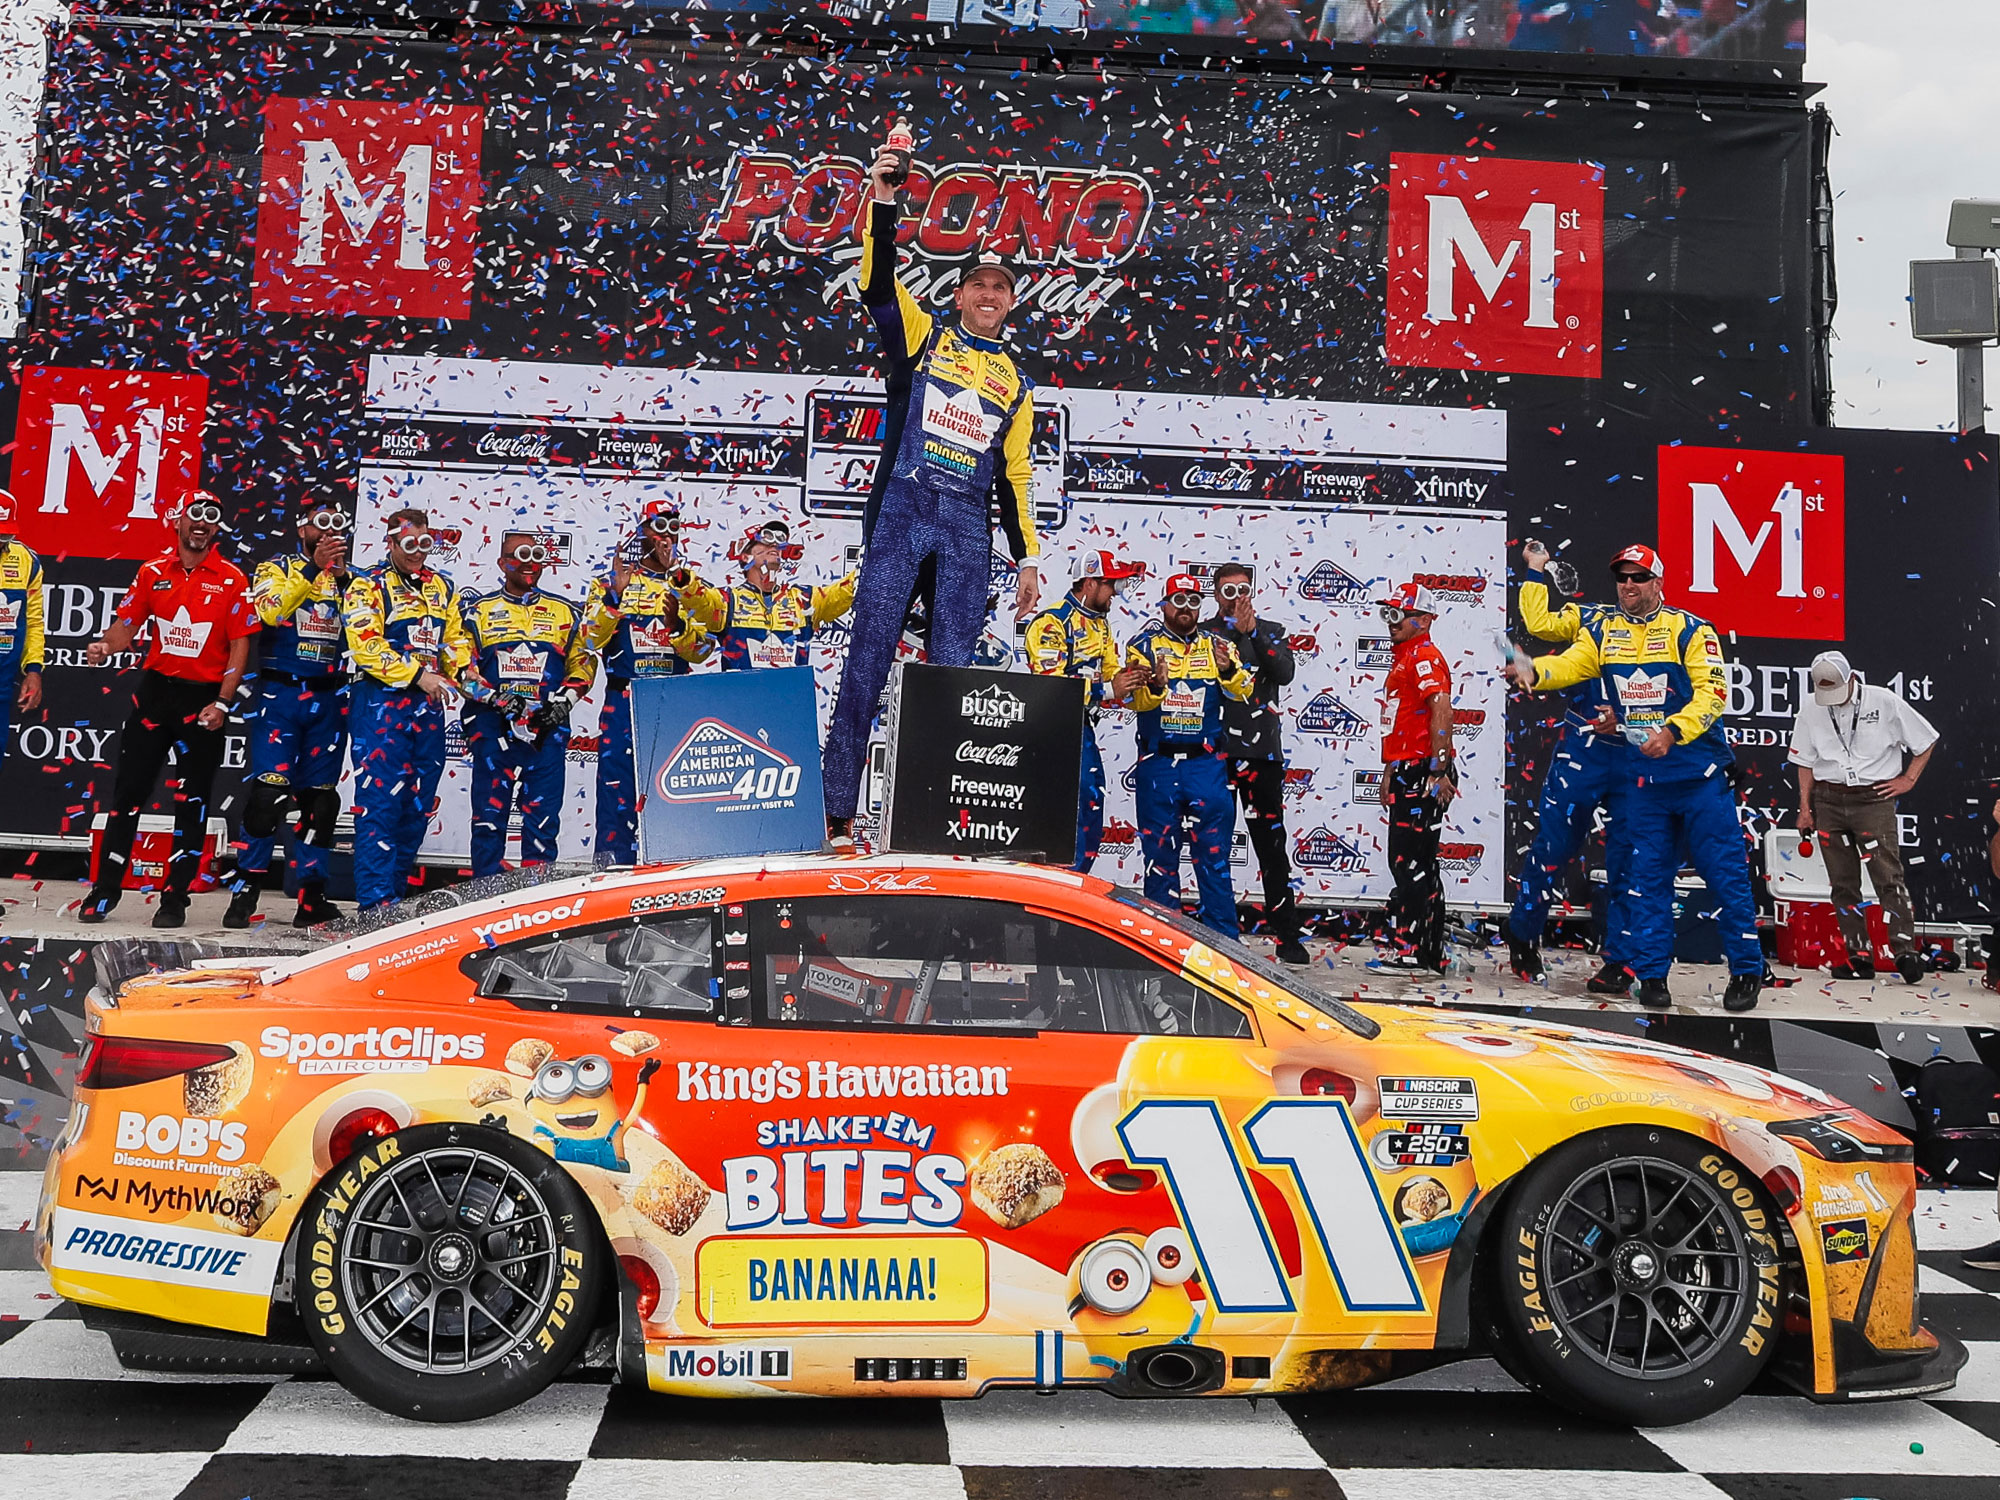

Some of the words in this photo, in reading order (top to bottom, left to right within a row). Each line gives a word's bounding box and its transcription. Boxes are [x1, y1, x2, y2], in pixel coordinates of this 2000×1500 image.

[827, 0, 861, 17] LIGH
[926, 409, 988, 444] Hawaiian
[944, 402, 984, 428] King's
[598, 437, 662, 463] Freeway
[925, 440, 977, 467] minions
[1303, 469, 1366, 490] Freeway
[1414, 475, 1488, 503] xfinity
[201, 583, 224, 593] TOYOTA
[1627, 681, 1653, 692] King's
[961, 695, 1026, 722] BUSCH
[973, 716, 1011, 728] LIGHT
[680, 754, 756, 772] AMERICAN
[688, 746, 708, 757] THE
[711, 744, 743, 754] GREAT
[955, 740, 1023, 767] Coca-Cola
[670, 771, 735, 788] GETAWAY
[732, 765, 802, 800] 400
[951, 775, 1025, 803] Freeway
[761, 800, 782, 810] VISIT
[784, 800, 795, 808] PA
[950, 795, 1023, 811] INSURANCE
[471, 898, 586, 944] yahoo!
[377, 934, 459, 967] NATIONAL
[395, 956, 418, 969] DEBT
[418, 948, 446, 962] RELIEF
[810, 969, 855, 993] TOYOTA
[259, 1025, 486, 1065] SportClips
[303, 1060, 424, 1073] HAIRCUTS
[677, 1060, 801, 1103] King's
[806, 1060, 1009, 1099] Hawaiian
[1409, 1080, 1461, 1093] NASCAR
[1395, 1097, 1419, 1109] CUP
[1421, 1097, 1464, 1110] SERIES
[115, 1110, 248, 1162] BOB'S
[1407, 1135, 1451, 1153] 250
[113, 1152, 175, 1171] Discount
[175, 1158, 241, 1178] Furniture
[125, 1179, 260, 1221] MythWorx
[722, 1149, 967, 1231] BITES
[1113, 1096, 1430, 1316] 11
[64, 1226, 248, 1277] PROGRESSIVE
[1826, 1234, 1866, 1250] SUNOCO
[749, 1257, 937, 1301] BANANAAA!
[1517, 1226, 1553, 1332] EAGLE
[535, 1247, 584, 1354] EAGLE
[668, 1349, 753, 1377] Mobil
